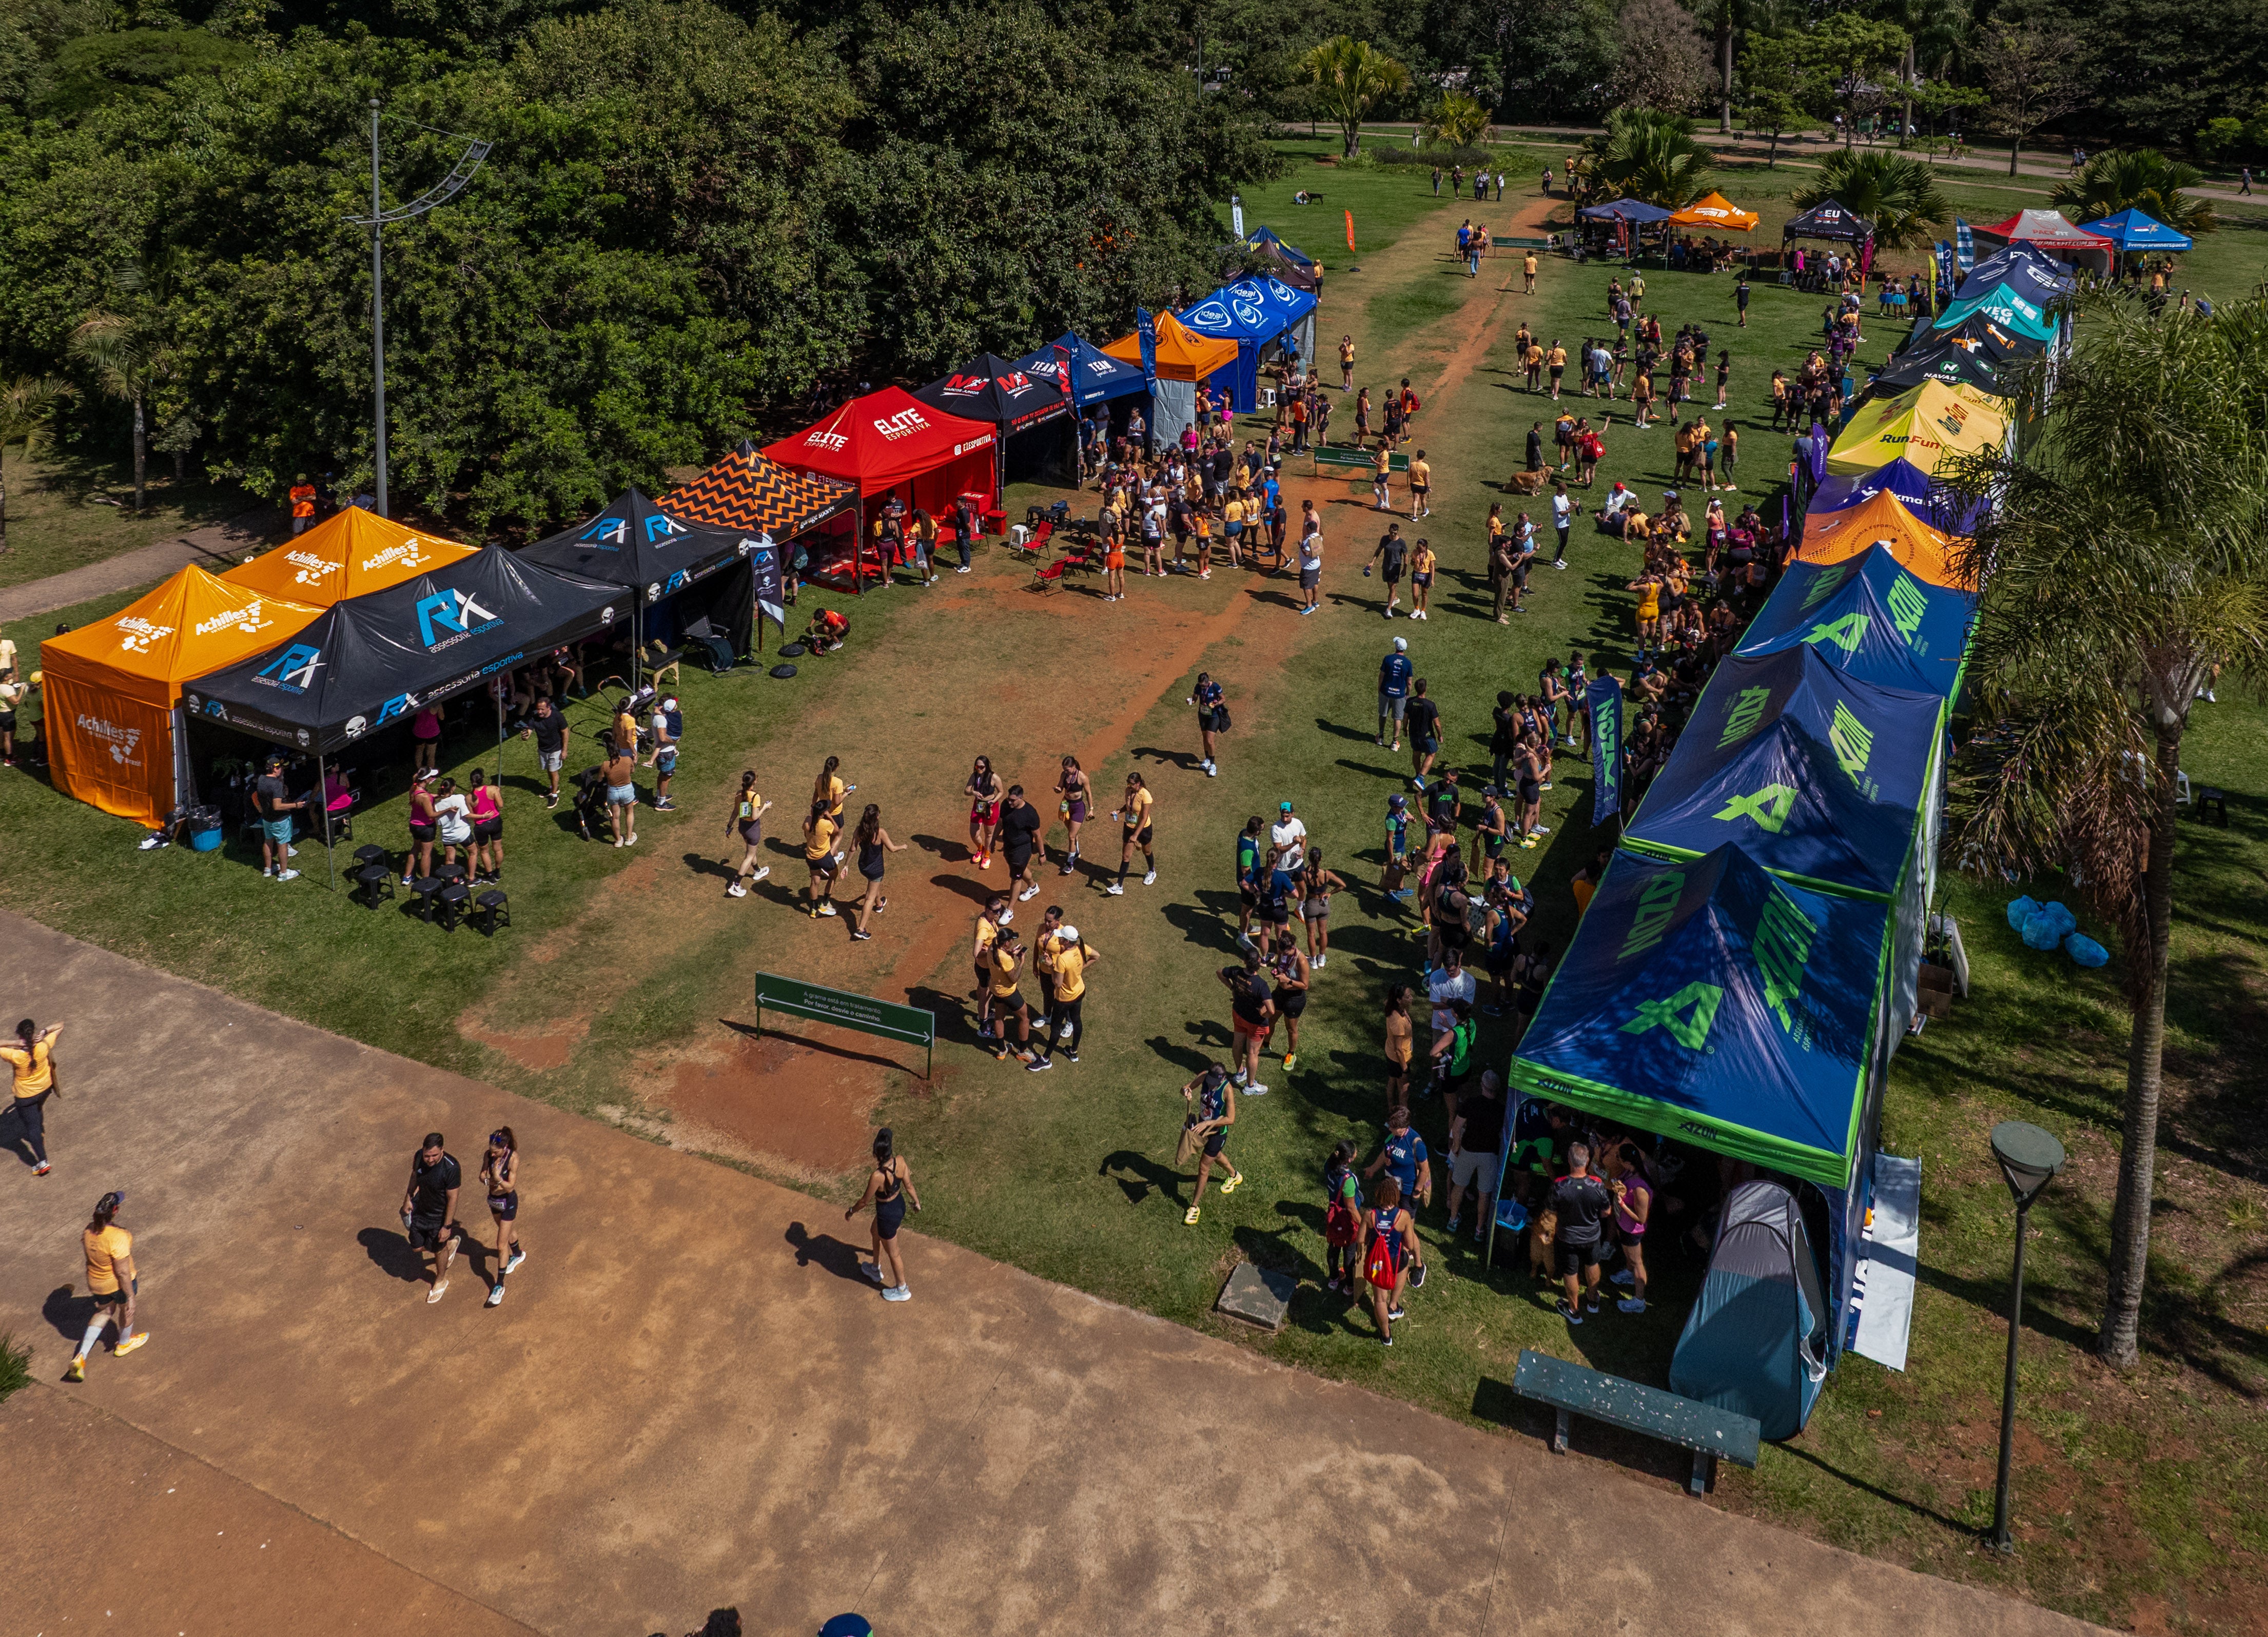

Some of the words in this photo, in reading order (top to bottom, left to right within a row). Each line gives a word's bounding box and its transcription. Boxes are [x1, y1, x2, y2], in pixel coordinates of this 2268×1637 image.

[1825, 209, 1841, 218] EU
[2032, 228, 2068, 236] PACEFIT
[1235, 288, 1257, 297] ideal
[1031, 361, 1057, 373] TEAM
[1087, 360, 1113, 372] TEAM
[1923, 372, 1972, 384] NAVASTRI
[873, 407, 926, 435] EL1TE
[1937, 403, 1969, 437] RunFun
[807, 431, 849, 448] EL1TE
[885, 421, 931, 441] ESPORTIVA
[803, 441, 840, 453] ESPORTIVA
[963, 433, 992, 452] E1ESPORTIVA
[1879, 433, 1940, 450] RunFun
[1850, 528, 1868, 554] ASSESSORIA
[284, 550, 326, 569] Achilles
[362, 545, 408, 571] Achilles
[1887, 569, 1929, 646] AZON
[114, 616, 158, 634] Achilles
[195, 608, 248, 636] Achilles
[428, 632, 472, 654] assessoria
[469, 618, 505, 636] esportiva
[427, 670, 480, 699] assessoria
[481, 652, 523, 675] esportiva
[251, 676, 280, 687] assessoria
[279, 682, 305, 696] esportiva
[76, 714, 124, 740] Achilles
[231, 715, 264, 731] assessoria
[264, 725, 293, 739] esportiva
[1596, 698, 1615, 787] AZON
[1828, 698, 1874, 790] AZON
[1751, 880, 1817, 1034] AZON
[809, 993, 827, 1001] grama
[815, 1001, 831, 1010] favor,
[831, 1005, 849, 1015] desvie
[855, 1012, 882, 1022] caminho.
[1537, 1078, 1574, 1095] AZON
[1677, 1121, 1718, 1140] AZON
[1392, 1146, 1406, 1159] ZON
